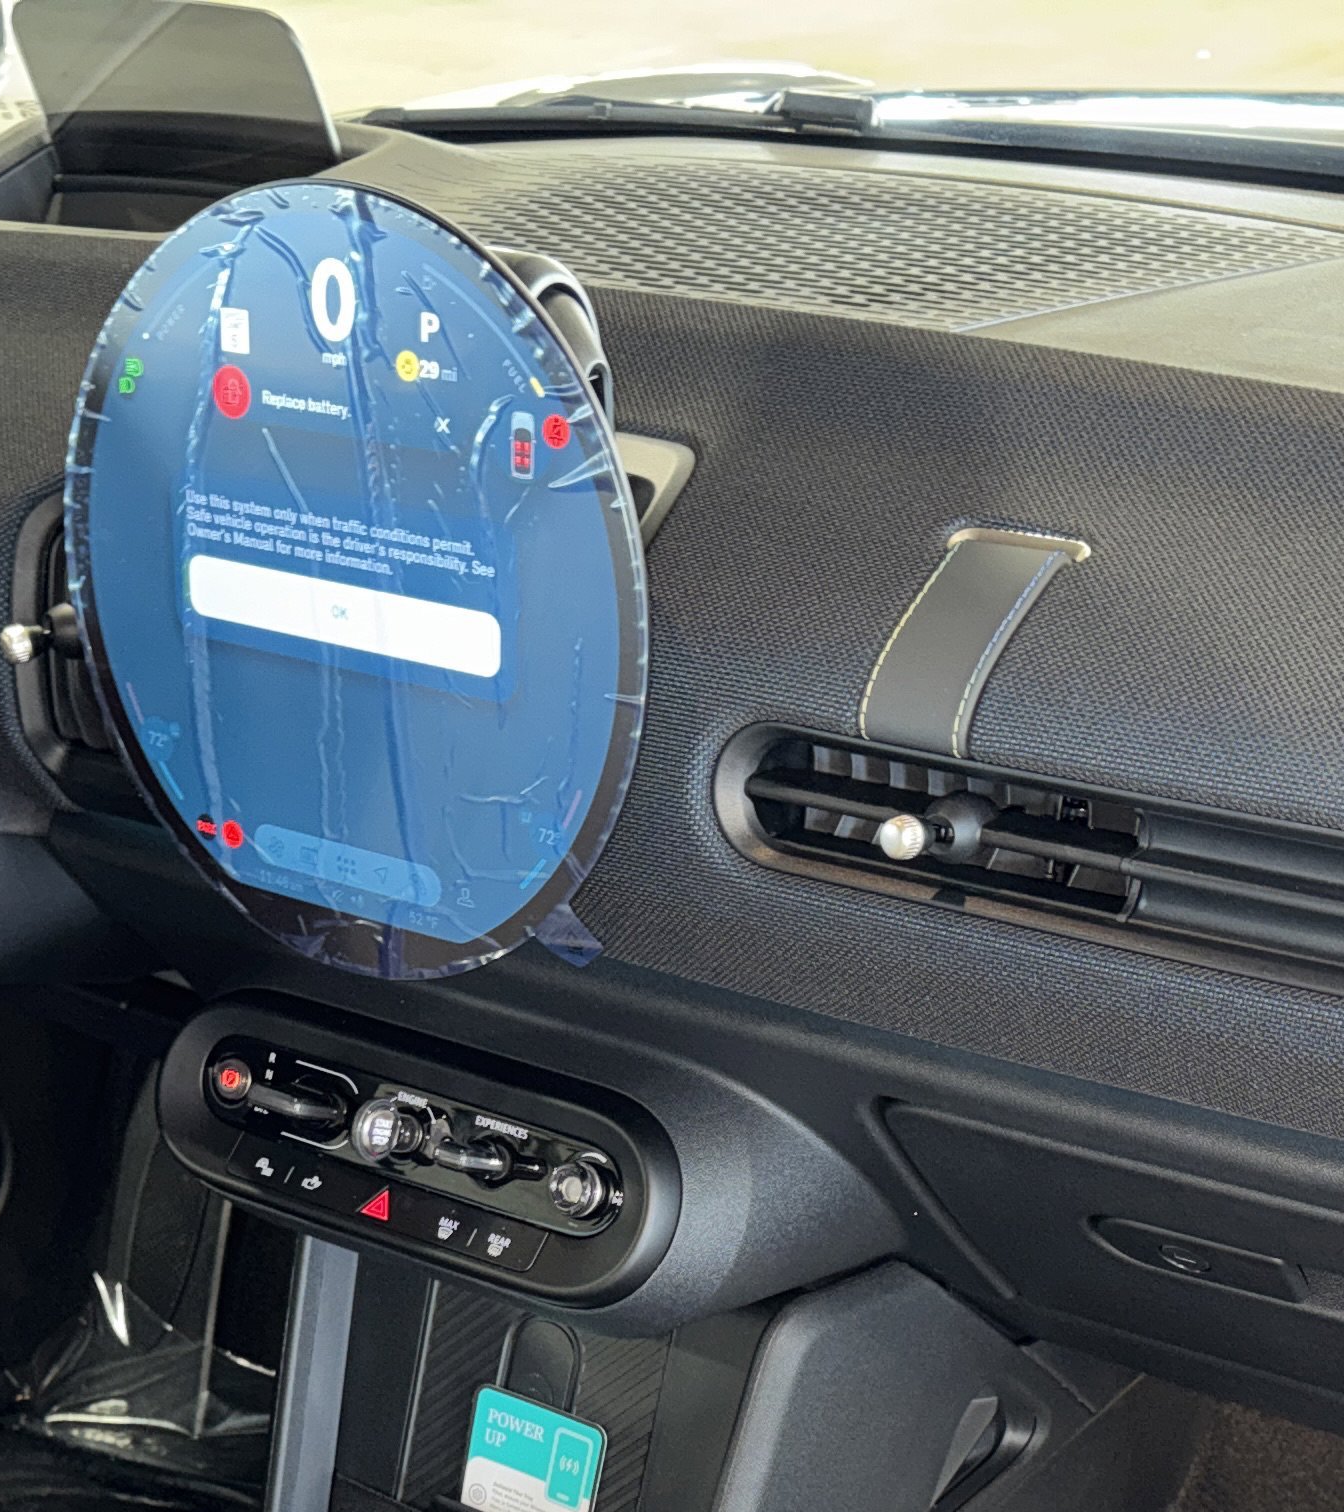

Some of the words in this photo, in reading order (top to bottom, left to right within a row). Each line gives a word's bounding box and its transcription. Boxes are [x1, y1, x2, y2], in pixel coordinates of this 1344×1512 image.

[311, 257, 356, 341] 0
[420, 312, 440, 342] P
[322, 350, 347, 368] mph
[420, 359, 440, 379] 29
[441, 366, 458, 382] mi
[502, 359, 527, 394] FUEL
[261, 389, 306, 411] Replace
[307, 396, 352, 420] battery.
[185, 489, 208, 506] Use
[208, 493, 231, 510] this
[232, 499, 272, 516] system
[273, 507, 298, 526] only
[299, 511, 331, 529] when
[332, 516, 368, 537] traffic
[369, 526, 431, 549] conditions
[186, 505, 213, 523] Safe
[213, 513, 253, 531] vehicle
[254, 521, 307, 543] operation
[308, 528, 320, 544] is
[320, 532, 342, 548] the
[342, 537, 387, 558] driver's
[387, 547, 469, 576] responsibility.
[471, 559, 496, 578] See
[186, 522, 233, 545] Owner's
[233, 530, 275, 552] Manual
[275, 539, 294, 556] for
[293, 545, 324, 562] more
[324, 549, 395, 576] information.
[331, 604, 349, 620] OK
[268, 1052, 277, 1064] R
[474, 1115, 530, 1140] EXPERIENCES
[438, 1215, 461, 1231] MAX
[487, 1232, 512, 1249] REAR
[484, 1427, 507, 1448] UP
[487, 1407, 546, 1443] POWER
